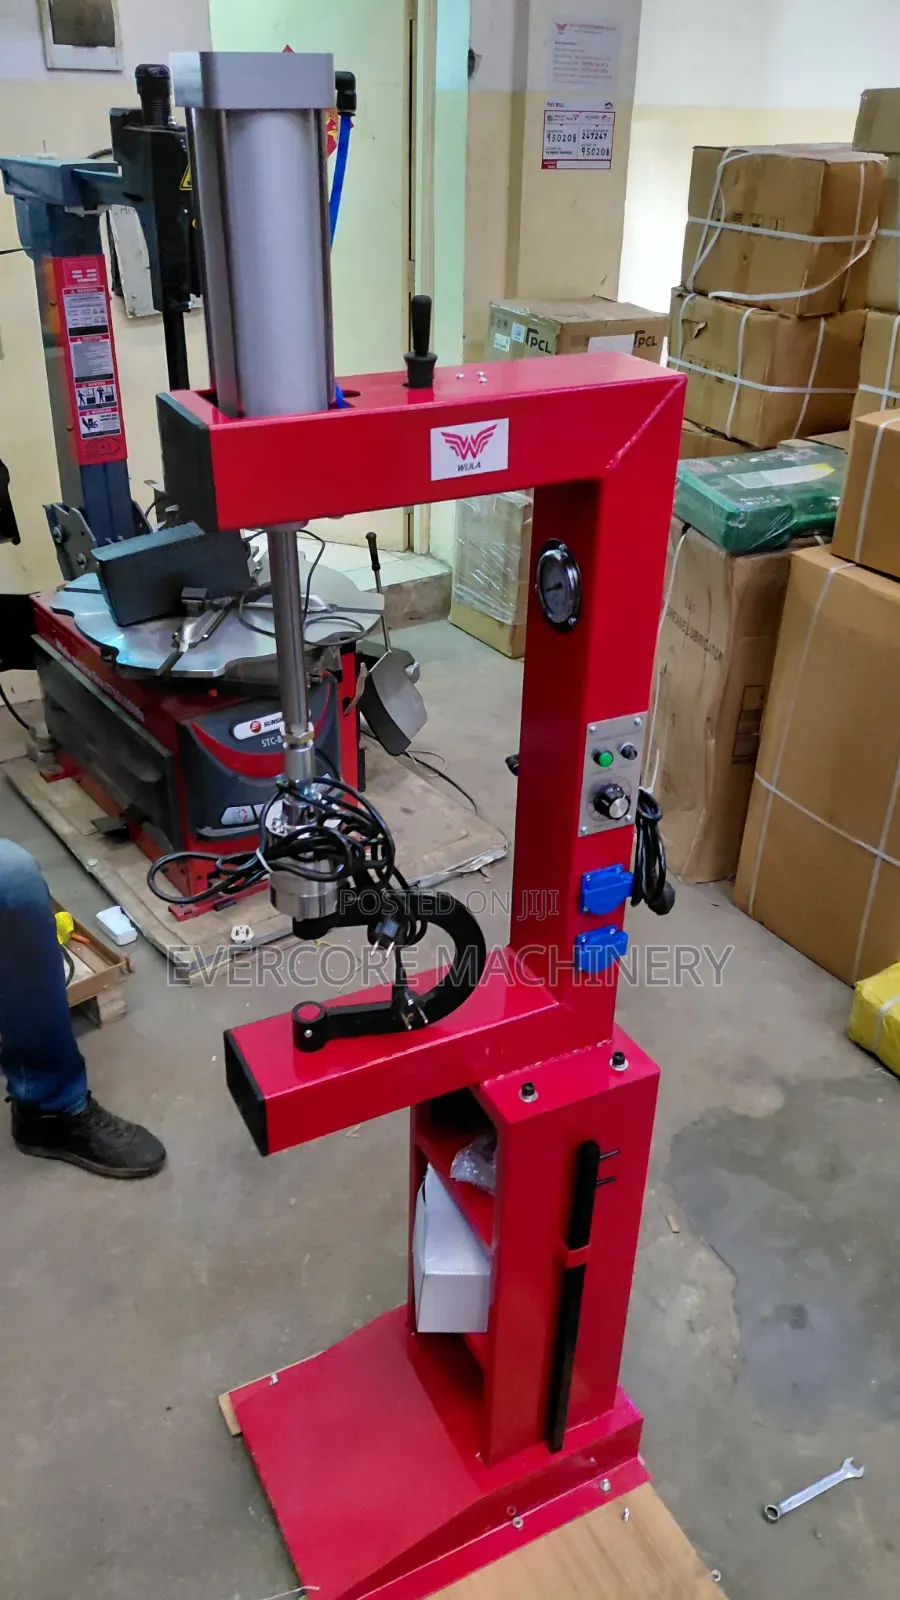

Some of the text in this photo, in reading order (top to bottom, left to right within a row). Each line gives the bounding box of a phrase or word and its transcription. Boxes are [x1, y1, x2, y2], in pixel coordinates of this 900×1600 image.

[546, 133, 577, 143] 950208
[581, 132, 608, 140] 247247
[581, 147, 610, 157] 950208
[457, 461, 481, 472] WULA
